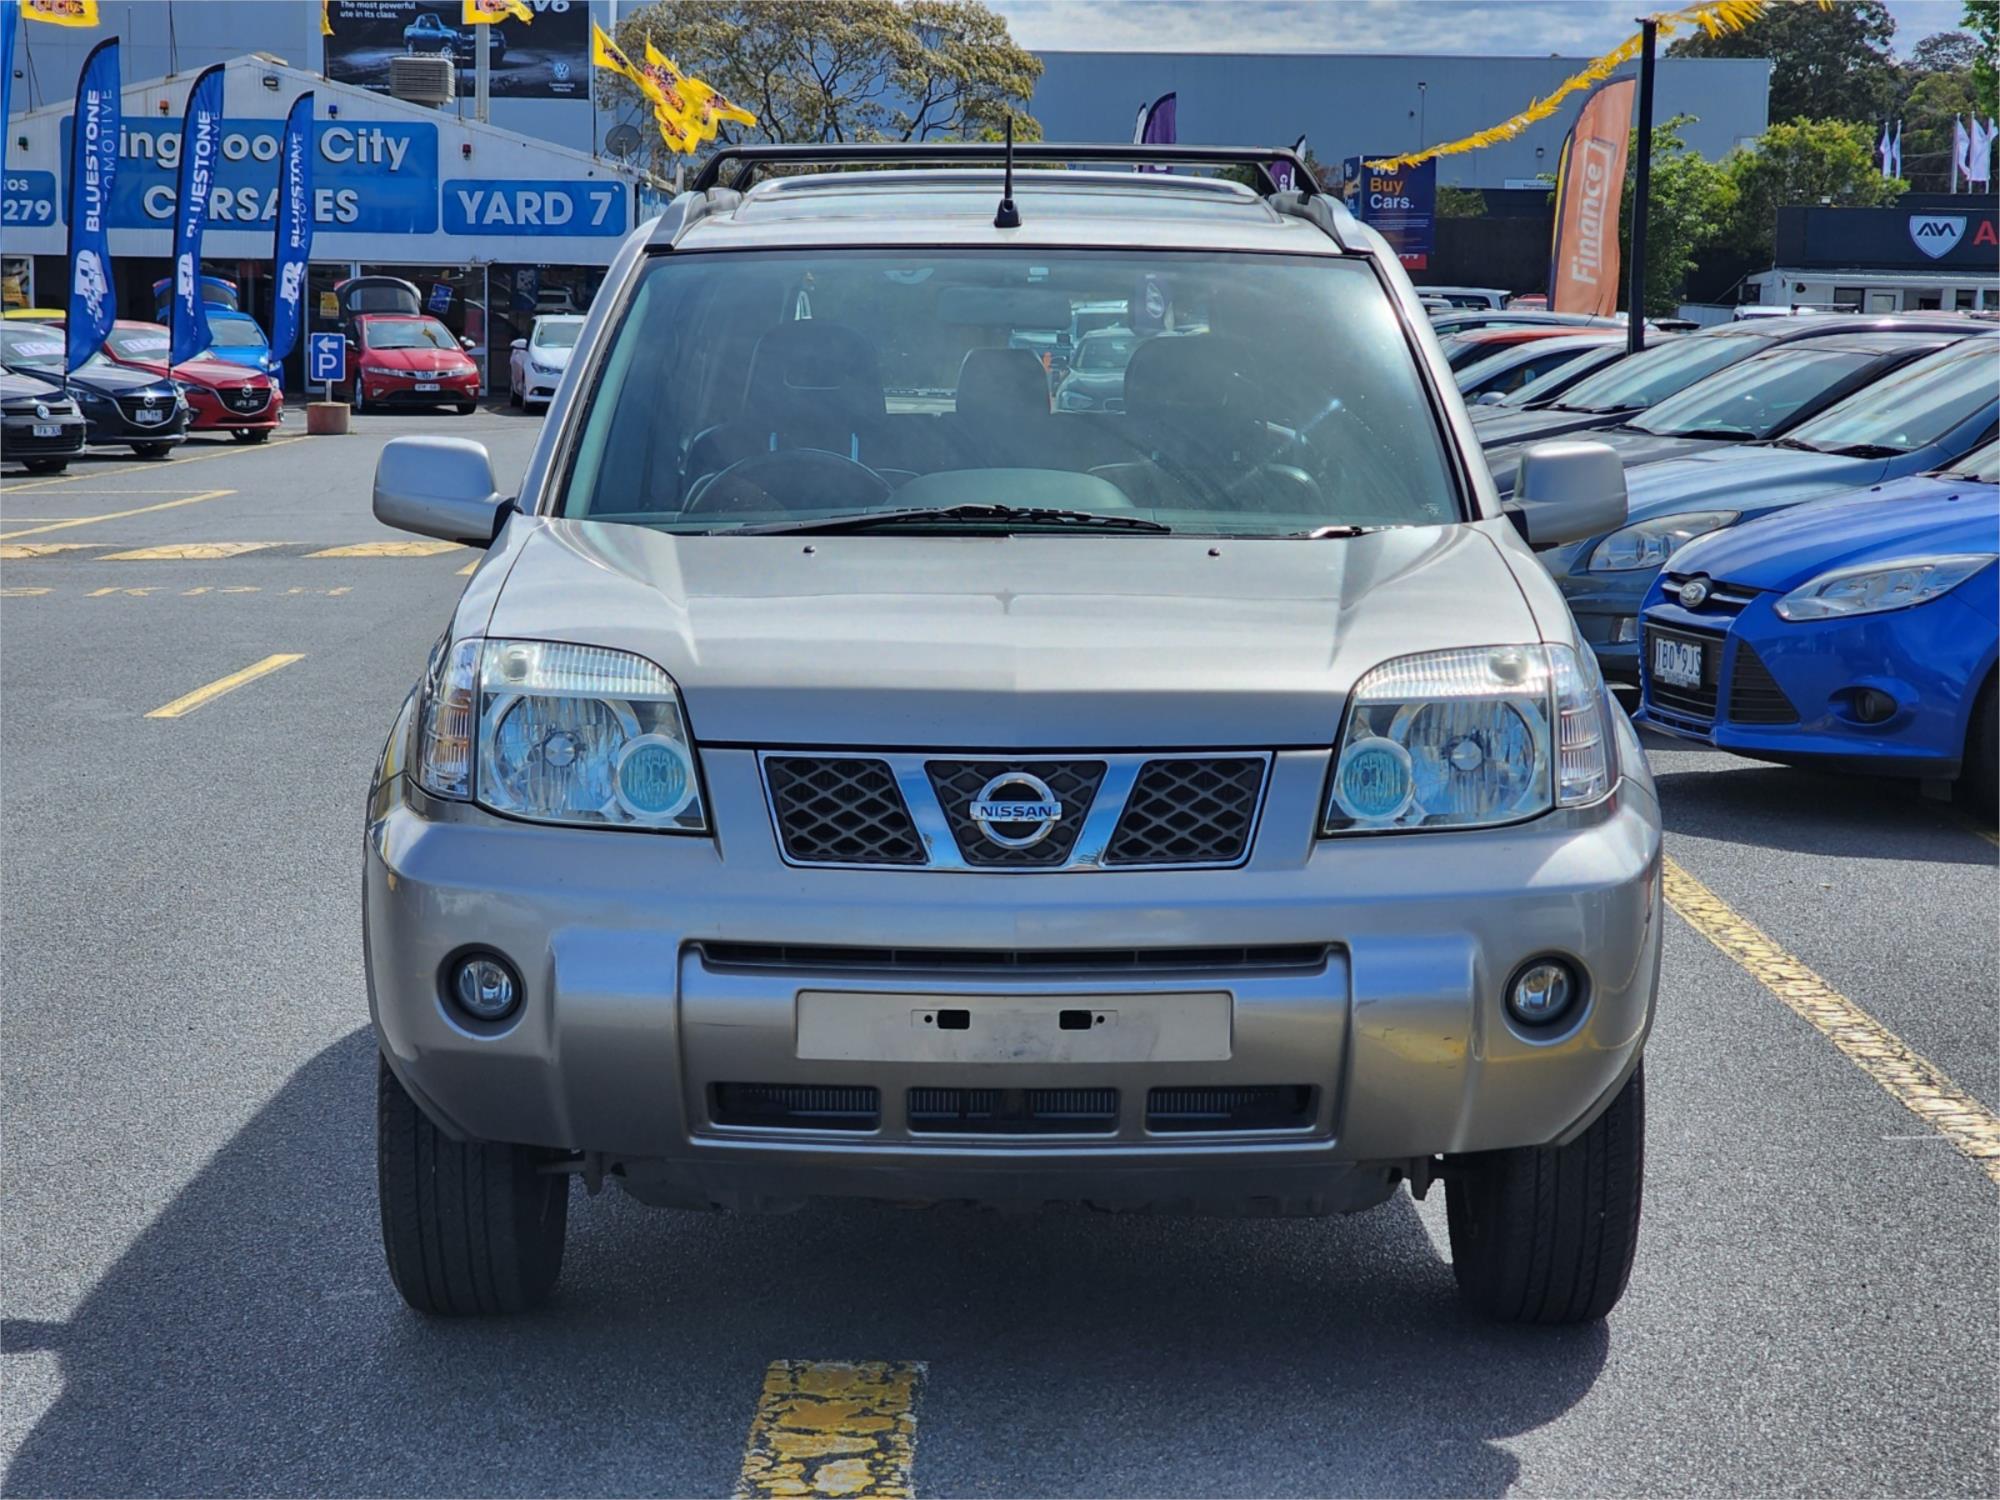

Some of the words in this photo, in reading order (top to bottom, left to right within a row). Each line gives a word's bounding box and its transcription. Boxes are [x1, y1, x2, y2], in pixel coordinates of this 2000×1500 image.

[340, 1, 355, 9] The
[379, 1, 416, 11] powerful
[340, 10, 354, 18] ute
[355, 10, 363, 18] in
[364, 10, 375, 18] its
[119, 124, 283, 168] ingoo
[320, 127, 410, 171] City
[85, 89, 101, 232] BLUESTONE
[1370, 177, 1403, 195] Buy
[143, 185, 359, 223] CRSAES
[457, 190, 574, 225] YARD
[589, 191, 612, 225] 7
[1370, 194, 1415, 209] Cars.
[1570, 162, 1602, 286] Finance
[318, 354, 337, 377] P
[980, 806, 1052, 817] NISSAN
